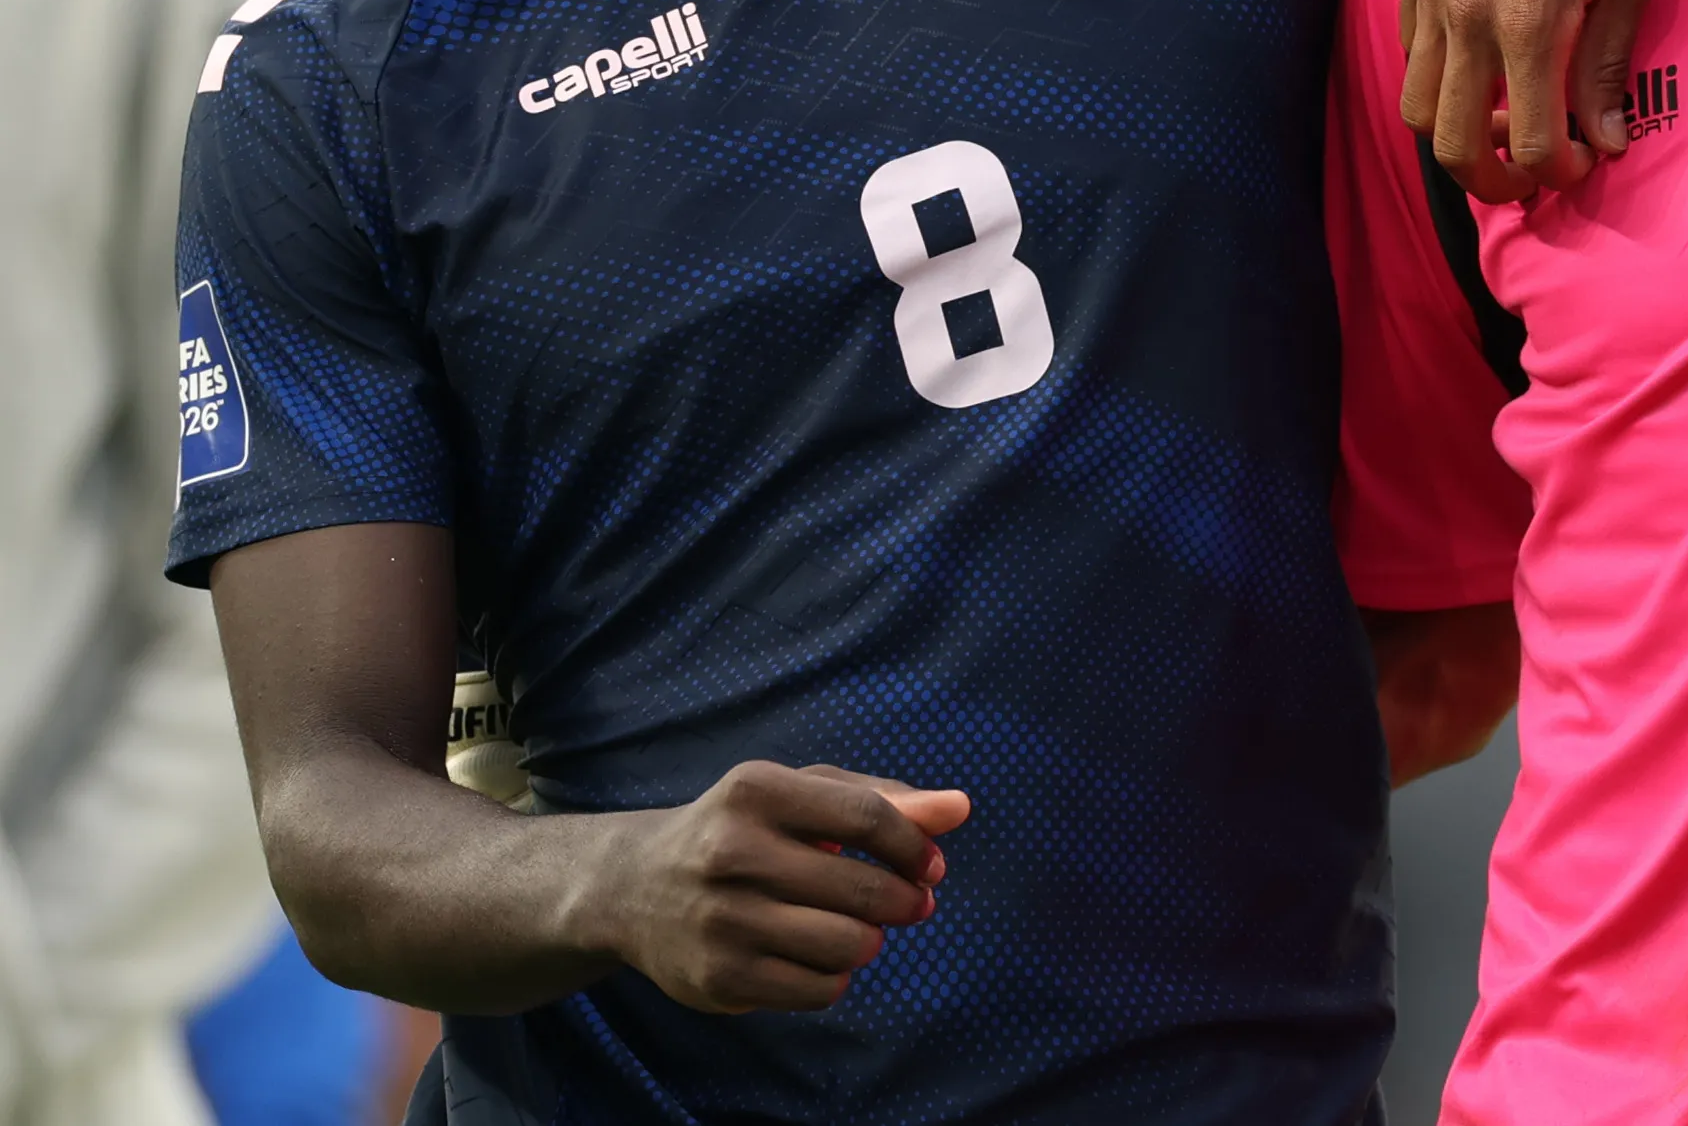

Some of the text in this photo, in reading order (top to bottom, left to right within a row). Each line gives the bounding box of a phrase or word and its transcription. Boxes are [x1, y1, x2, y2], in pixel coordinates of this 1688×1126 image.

[518, 1, 707, 114] capelli
[610, 43, 709, 95] SPORT
[1626, 113, 1679, 142] ORT
[860, 140, 1055, 409] 8
[179, 336, 212, 372] FA
[179, 363, 228, 404] RIES
